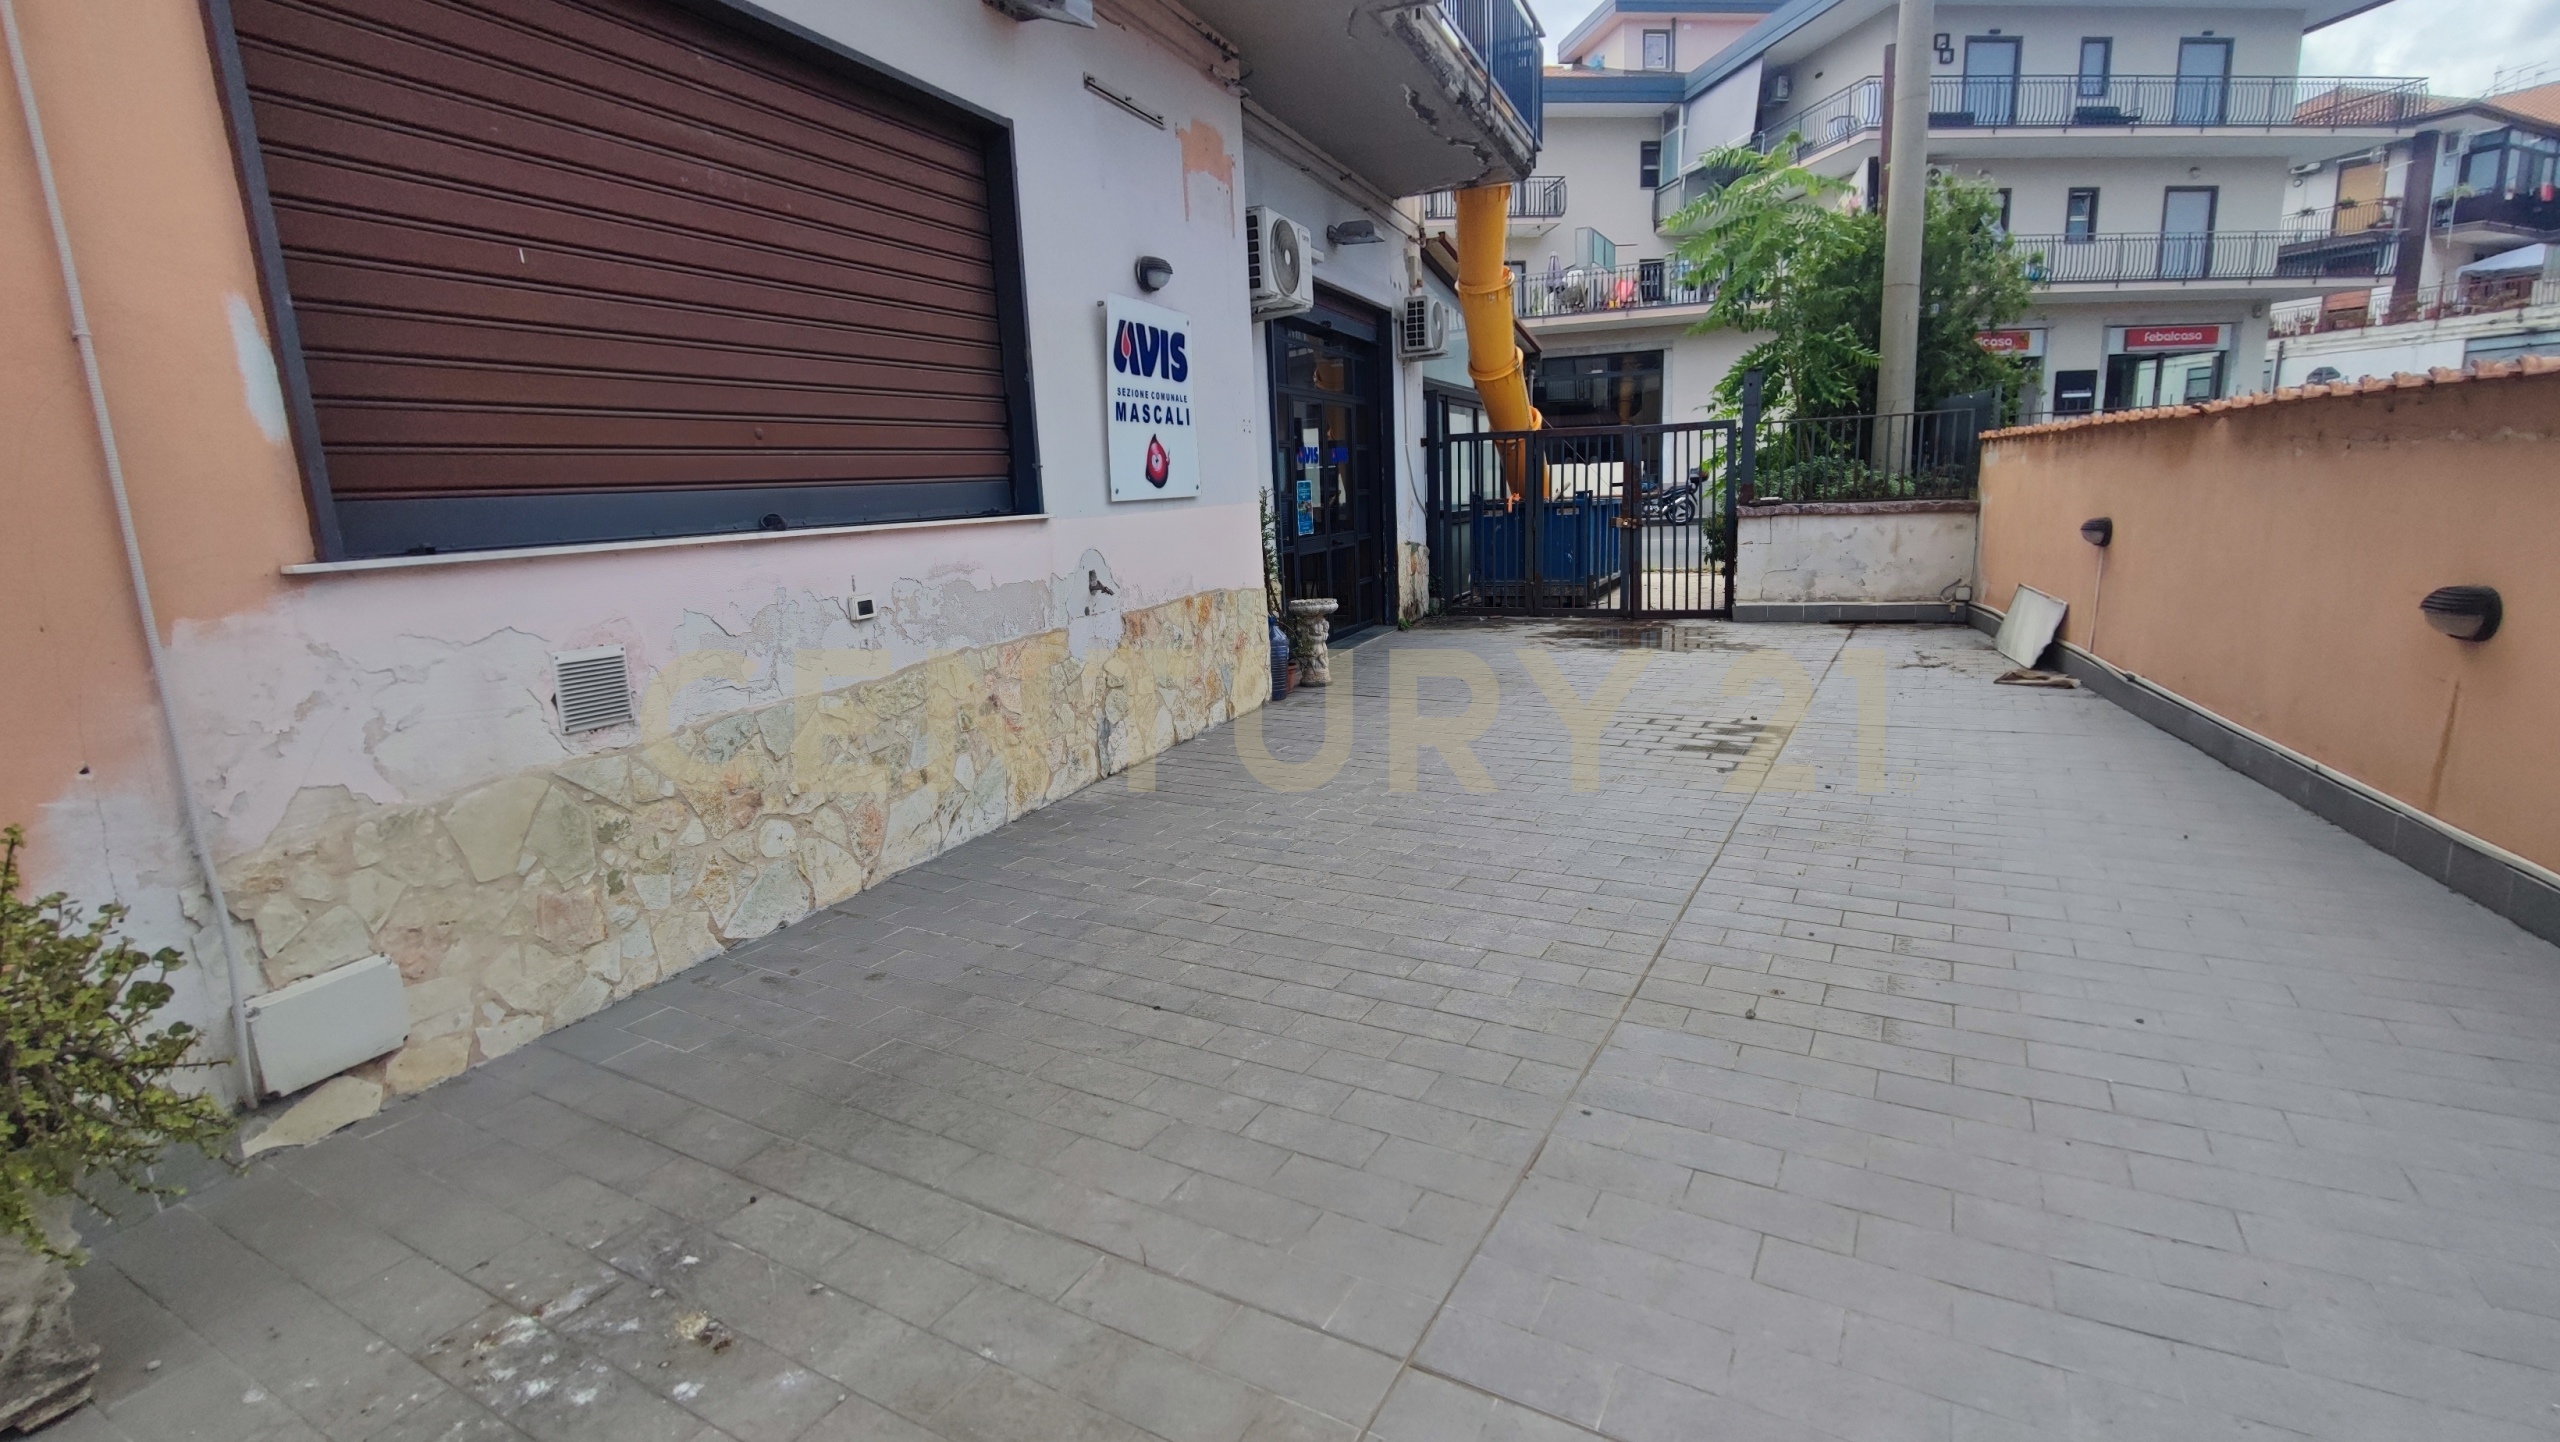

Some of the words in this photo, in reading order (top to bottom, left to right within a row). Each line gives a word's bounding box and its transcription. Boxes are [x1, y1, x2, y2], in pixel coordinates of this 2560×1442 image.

[2143, 331, 2203, 343] febalcasa
[1113, 319, 1188, 383] AVIS
[1117, 387, 1149, 400] SEZIONE
[1151, 391, 1188, 404] COMUNALE
[1115, 401, 1190, 426] MASCALI
